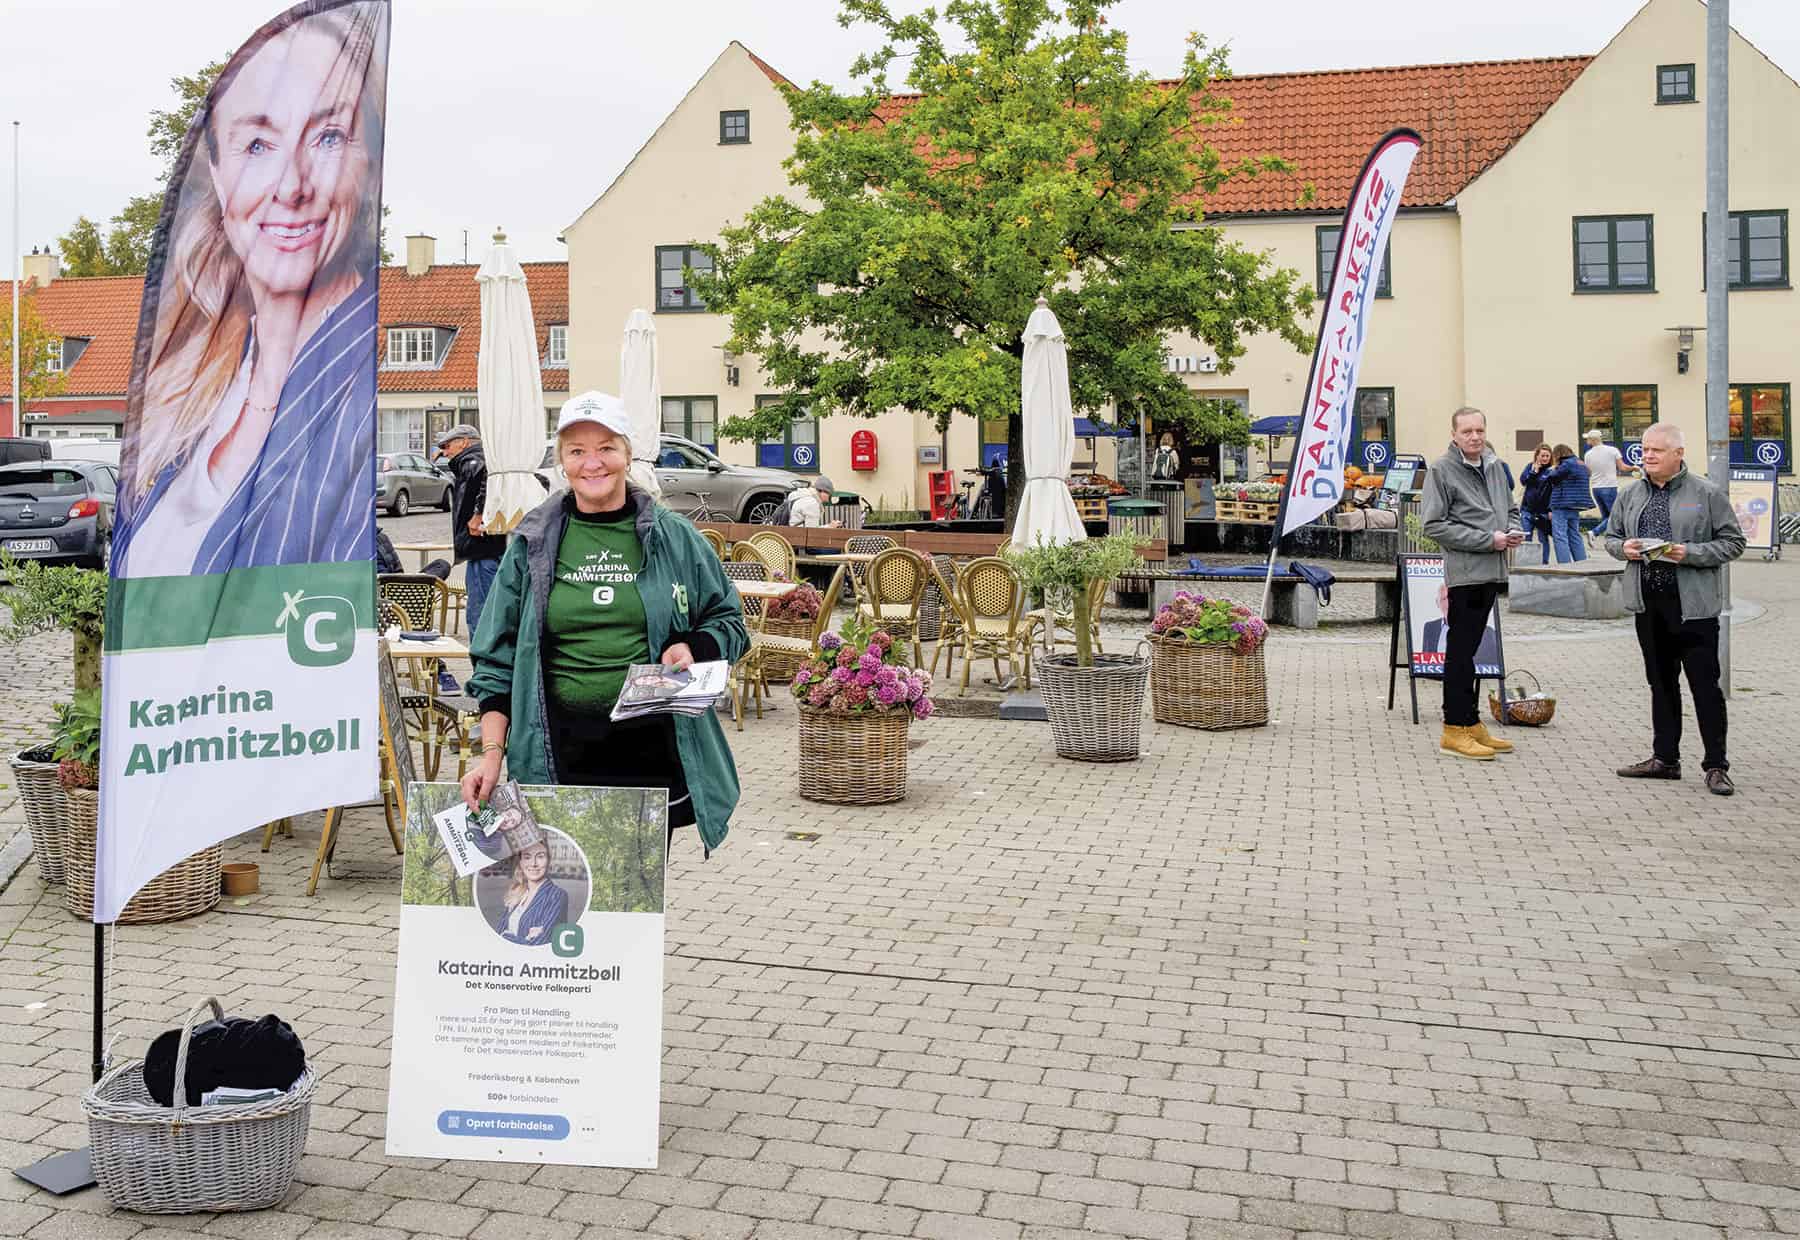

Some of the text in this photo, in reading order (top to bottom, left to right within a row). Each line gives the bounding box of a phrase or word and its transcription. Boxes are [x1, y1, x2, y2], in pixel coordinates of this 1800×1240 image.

[1168, 355, 1217, 374] ma
[1733, 470, 1765, 480] Irma
[578, 563, 630, 573] KATARINA
[303, 611, 338, 652] C
[559, 930, 576, 951] C
[438, 960, 621, 981] Katarina Ammitzbøll
[465, 981, 592, 994] Det Konservative Folkeparti
[483, 1006, 570, 1019] Fra Plan til Handling
[468, 1072, 580, 1085] Frederiksberg & København
[487, 1093, 560, 1104] 500+ forbindelser
[466, 1119, 554, 1132] Opret forbindelse
